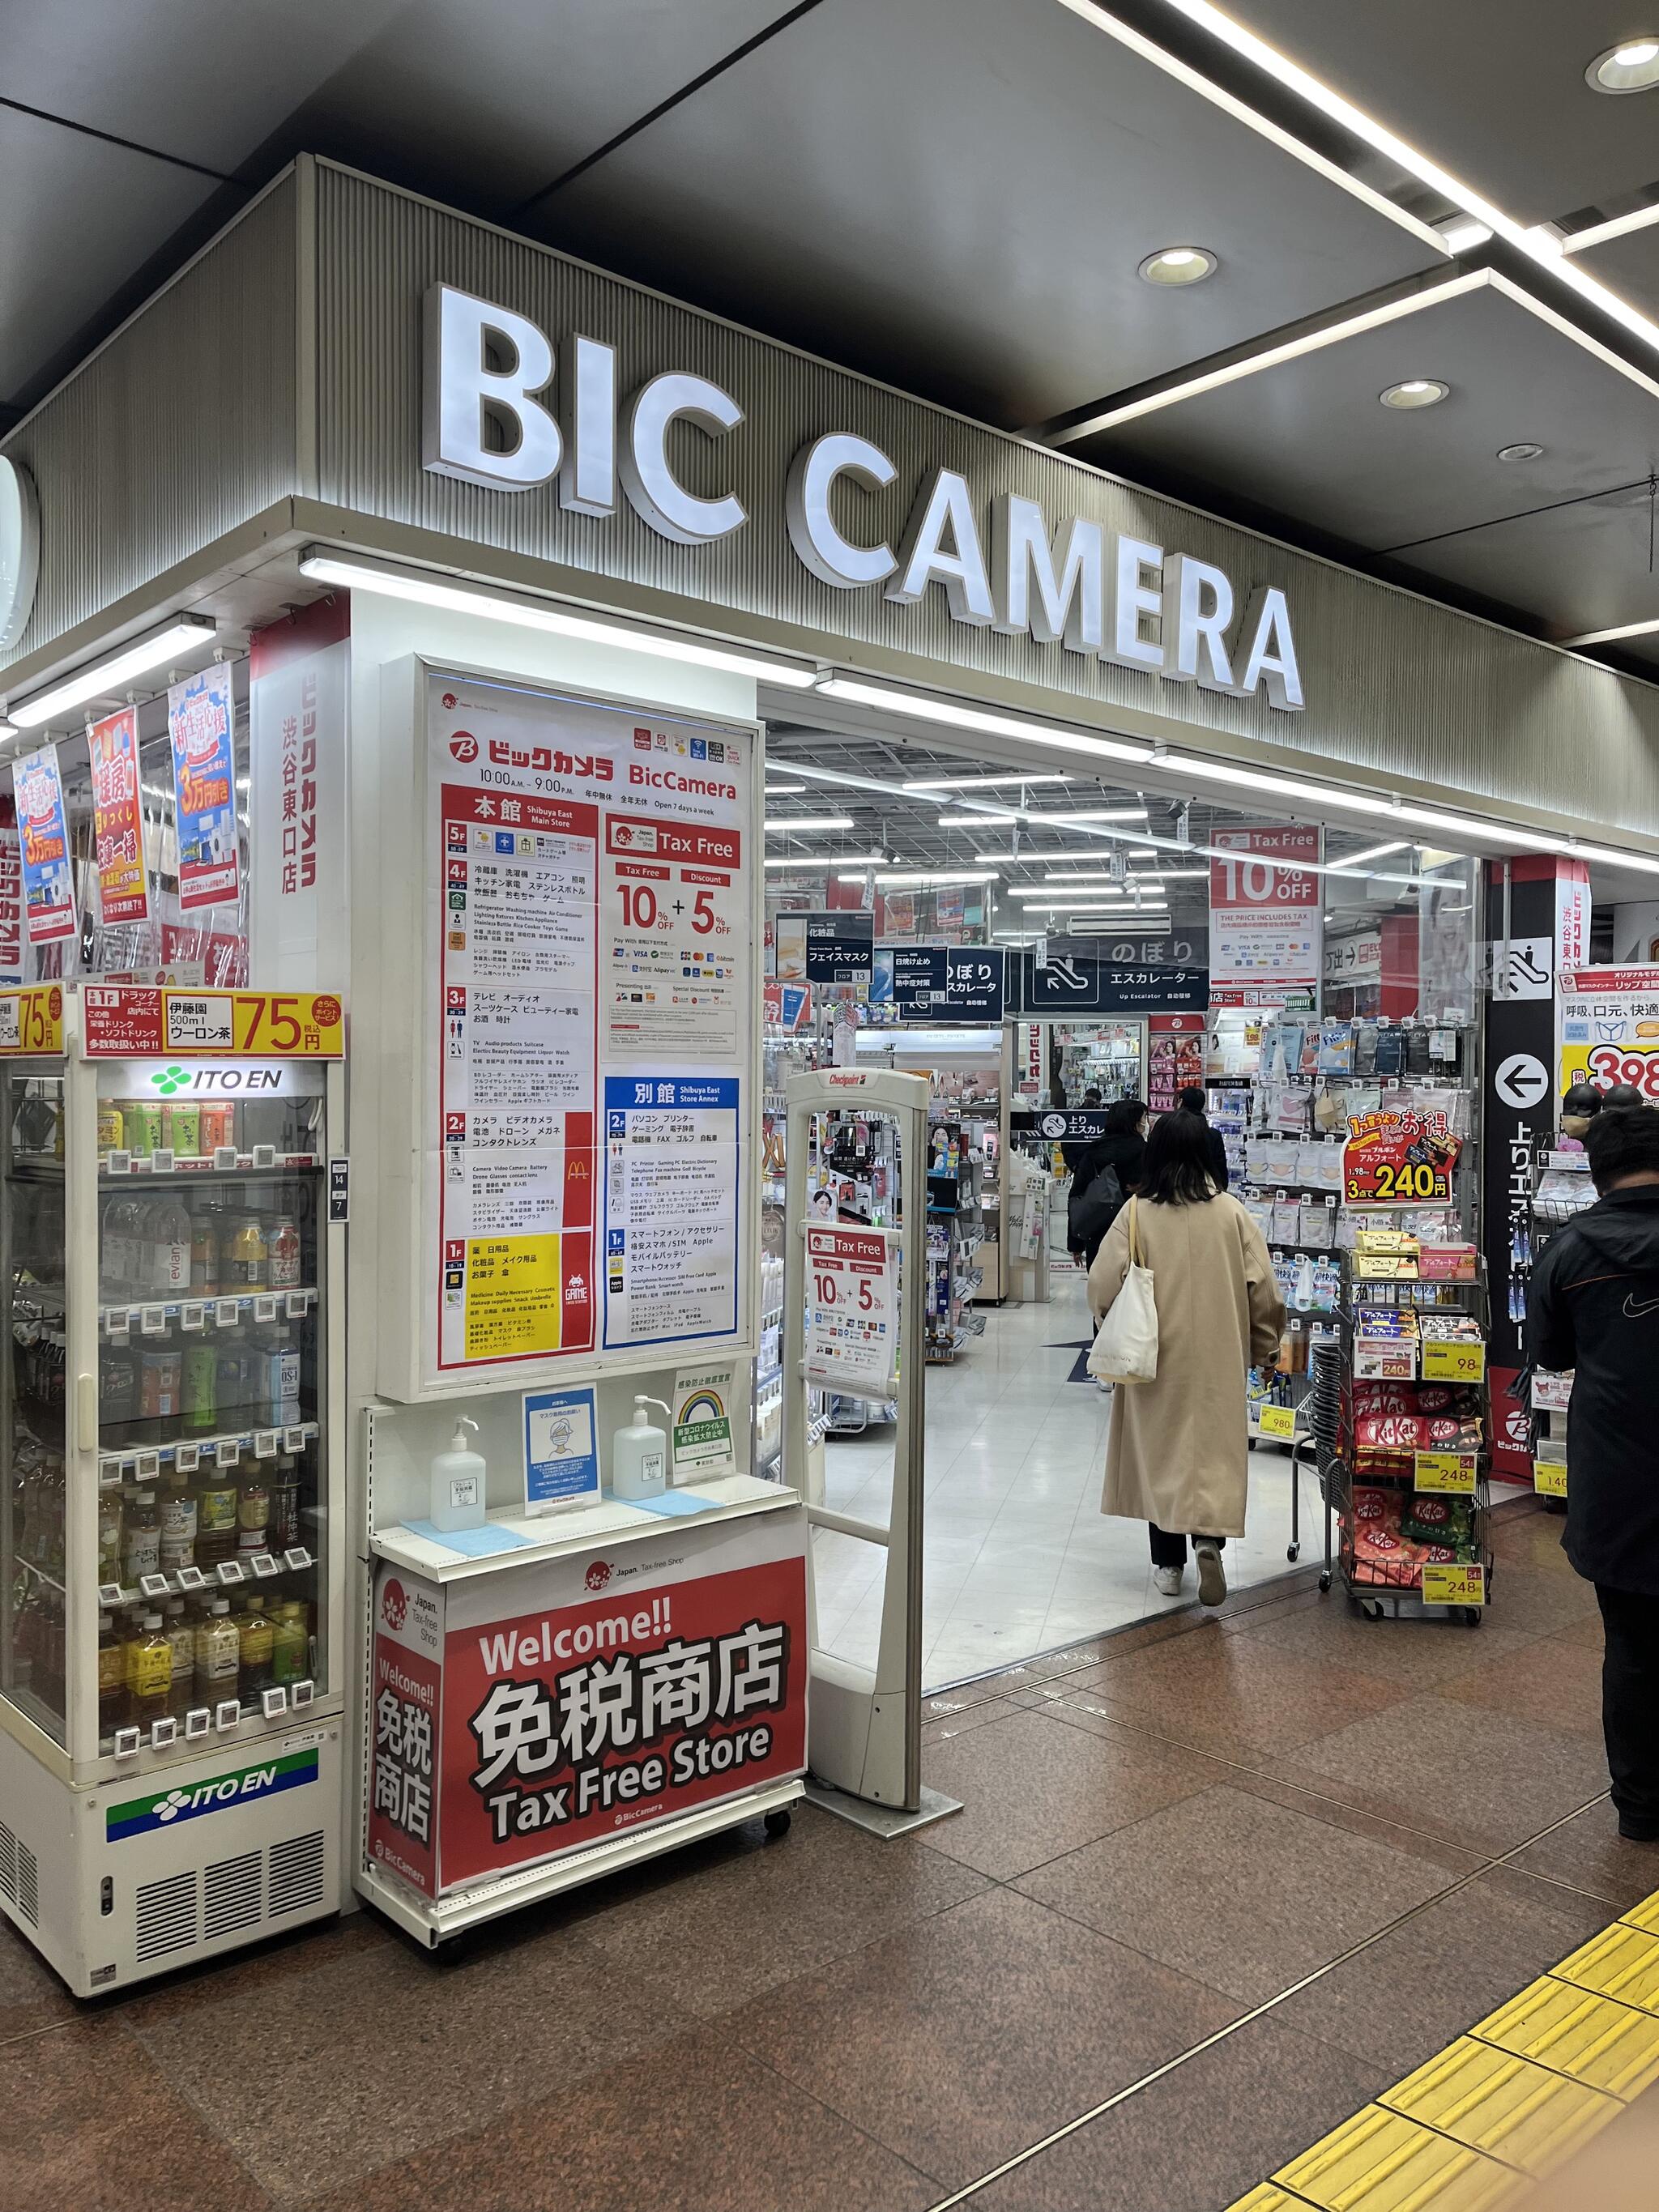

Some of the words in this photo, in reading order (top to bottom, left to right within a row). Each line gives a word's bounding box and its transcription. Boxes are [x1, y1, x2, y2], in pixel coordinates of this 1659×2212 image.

[426, 282, 748, 543] BIC
[786, 431, 1305, 710] CAMERA
[488, 739, 614, 782] ビックカメラ
[629, 764, 736, 800] BicCamera
[99, 754, 126, 808] 暖房
[301, 672, 317, 888] ビックカメラ
[179, 765, 229, 817] 3万円引き
[480, 769, 510, 785] 10:00
[535, 777, 561, 793] 9:00
[655, 800, 672, 810] Open
[282, 715, 297, 894] 渋谷東口店
[474, 795, 522, 823] 本館
[527, 805, 557, 817] Shibuya
[557, 810, 573, 819] East
[531, 816, 550, 826] Main
[551, 819, 570, 829] Store
[659, 833, 692, 853] Tax
[697, 837, 733, 858] Free
[1252, 834, 1279, 847] Tax
[1282, 833, 1314, 846] Free
[449, 864, 466, 878] 4F
[535, 872, 565, 882] エアコン
[625, 866, 640, 874] Tax
[642, 868, 659, 877] Free
[690, 872, 721, 884] Discount
[1218, 854, 1274, 901] 10
[474, 877, 521, 889] キッチン家電
[528, 882, 586, 895] ステンレスボトル
[1276, 883, 1311, 900] OFF
[616, 884, 657, 928] 10
[690, 890, 714, 935] 5
[657, 921, 674, 931] OFF
[715, 927, 731, 935] OFF
[809, 928, 835, 938] 化粧品
[809, 953, 869, 962] フェイスマスク
[1111, 940, 1192, 963] のぼり
[895, 957, 931, 965] 日焼け止め
[855, 972, 865, 980] 13
[895, 978, 931, 987] 熱中症対策
[1111, 972, 1200, 984] エスカレーター
[99, 991, 113, 1004] 1F
[122, 990, 157, 1000] ドラッグ
[449, 991, 465, 1004] 3F
[473, 992, 496, 1002] テレビ
[503, 994, 540, 1004] オーディオ
[127, 1008, 159, 1016] 店内にて
[169, 1003, 207, 1015] 伊藤園
[473, 1004, 518, 1013] スーツケース
[522, 1006, 579, 1016] ビューティー家電
[21, 992, 45, 1047] 75
[90, 1020, 134, 1029] 栄養ドリンク
[236, 997, 301, 1050] 75
[473, 1015, 488, 1024] お酒
[171, 1027, 231, 1040] ウーロン茶
[305, 1034, 320, 1050] 円
[193, 1070, 241, 1089] ITO
[245, 1070, 282, 1089] EN
[829, 1074, 859, 1087] Checkpoint
[634, 1083, 676, 1104] 別館
[680, 1086, 706, 1094] Shibuya
[449, 1117, 464, 1130] 2F
[473, 1116, 497, 1125] カメラ
[505, 1116, 552, 1125] ビデオカメラ
[611, 1115, 625, 1127] 2F
[1068, 1115, 1087, 1125] 上り
[1349, 1112, 1400, 1137] 1つ買うより
[1401, 1109, 1448, 1140] お得
[538, 1127, 561, 1135] メガネ
[1068, 1125, 1106, 1134] エスカレ
[472, 1138, 537, 1147] コンタクトレンズ
[676, 1135, 694, 1143] ゴルフ
[1358, 1153, 1401, 1162] アルフォート
[335, 1175, 343, 1184] 14
[1347, 1180, 1373, 1199] 3点で
[1375, 1165, 1434, 1197] 240
[1435, 1183, 1446, 1196] 円
[336, 1202, 342, 1211] 7
[612, 1233, 622, 1246] 1F
[630, 1230, 681, 1239] スマートフォン
[687, 1226, 725, 1235] アクセサリー
[693, 1238, 714, 1246] Apple
[450, 1243, 463, 1258] 1F
[836, 1239, 854, 1253] Tax
[857, 1242, 881, 1255] Free
[170, 1247, 181, 1280] evian
[501, 1255, 537, 1265] メイク用品
[630, 1250, 693, 1262] モバイルバッテリー
[1423, 1258, 1456, 1266] アルフォート
[630, 1262, 682, 1272] スマートウォッチ
[855, 1265, 877, 1273] Discount
[814, 1274, 837, 1304] 10
[858, 1280, 873, 1311] 5
[1364, 1311, 1397, 1319] アルフォート
[1366, 1327, 1398, 1335] アルフォート
[1425, 1319, 1458, 1328] アルフォート
[1383, 1365, 1405, 1375] 240
[1457, 1358, 1476, 1370] 98
[1422, 1391, 1447, 1409] KitKat
[677, 1421, 726, 1436] 新型コロナウイルス
[1273, 1418, 1290, 1429] 980
[1374, 1417, 1416, 1445] KitKat
[680, 1430, 723, 1443] 感染拡大防止中
[1439, 1470, 1468, 1481] 248
[1418, 1502, 1446, 1520] KitKat
[616, 1566, 638, 1578] Japan.
[641, 1562, 666, 1573] Tax-free
[667, 1557, 684, 1569] Shop
[1448, 1582, 1477, 1593] 248
[415, 1592, 437, 1614] Japan.
[412, 1609, 438, 1632] Tax-free
[420, 1629, 437, 1647] Shop
[478, 1596, 672, 1675] Welcome!!
[379, 1657, 434, 1707] Welcome!!
[473, 1622, 784, 1788] 免税商店
[375, 1689, 432, 1775] 免税
[190, 1779, 239, 1809] ITO
[241, 1767, 276, 1794] EN
[488, 1787, 569, 1838] Tax
[579, 1763, 663, 1813] Free
[673, 1726, 770, 1773] Store
[374, 1752, 430, 1843] 商店
[623, 1802, 663, 1822] BicCamera
[384, 1844, 426, 1887] BicCamera
